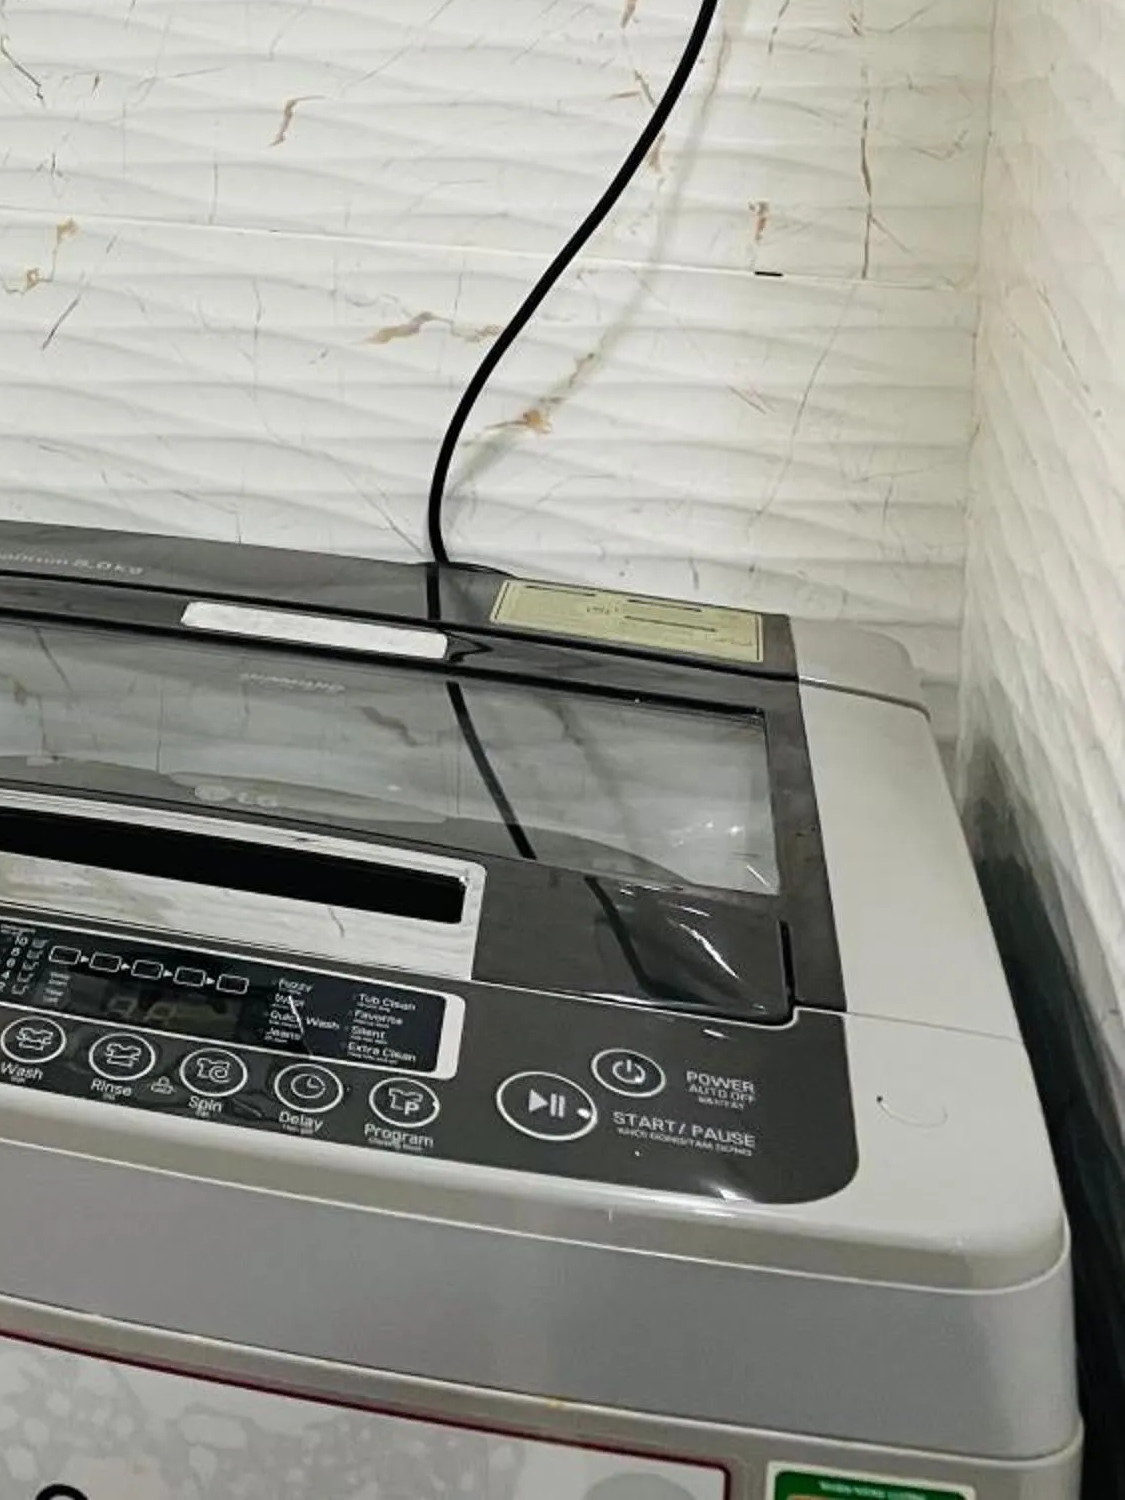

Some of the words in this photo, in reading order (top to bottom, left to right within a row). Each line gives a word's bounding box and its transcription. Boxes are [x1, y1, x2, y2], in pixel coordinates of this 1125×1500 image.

[14, 936, 29, 947] 10
[1, 970, 10, 980] 4
[359, 993, 380, 1005] Tub
[382, 998, 416, 1011] Clean
[306, 1017, 340, 1030] Wash
[354, 1009, 403, 1025] Favorite
[350, 1025, 386, 1039] Silent
[347, 1041, 380, 1057] Extra
[382, 1047, 417, 1062] Clean
[0, 1061, 44, 1080] Wash
[90, 1078, 133, 1097] Rinse
[686, 1070, 755, 1094] POWER
[688, 1083, 727, 1099] AUTO
[730, 1091, 756, 1103] OFF
[188, 1096, 223, 1113] Spin
[278, 1111, 324, 1132] Delay
[363, 1123, 434, 1148] Program
[691, 1124, 756, 1149] PAUSE
